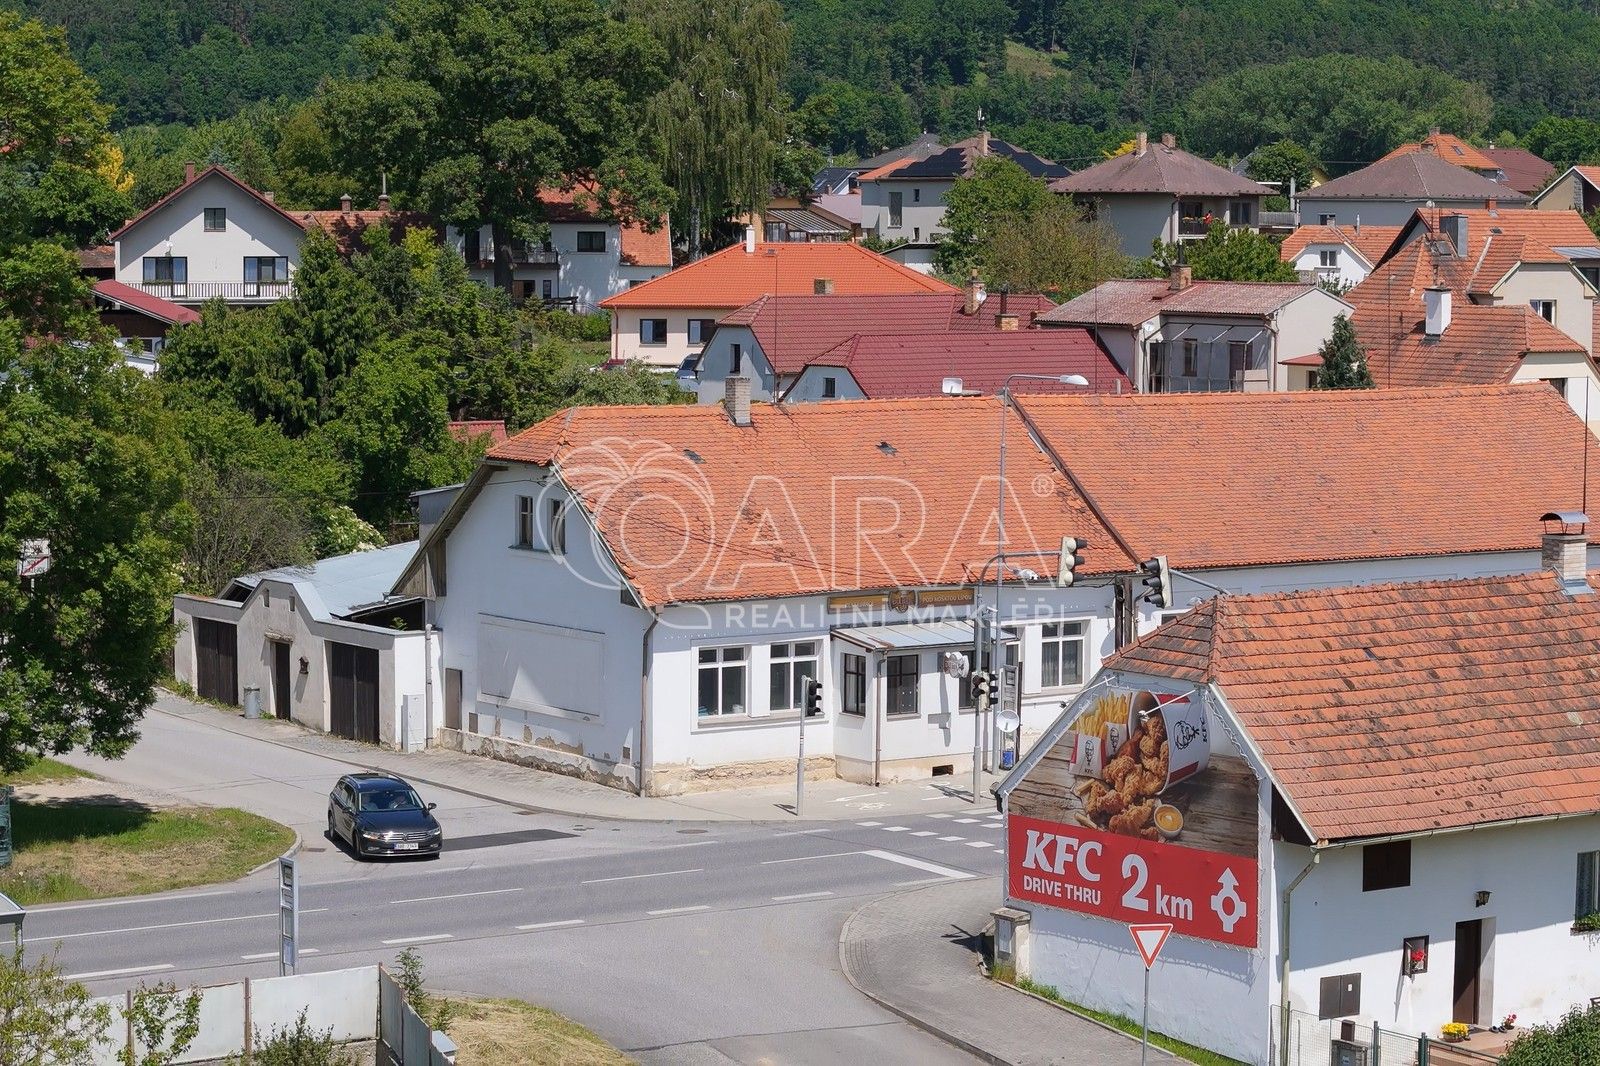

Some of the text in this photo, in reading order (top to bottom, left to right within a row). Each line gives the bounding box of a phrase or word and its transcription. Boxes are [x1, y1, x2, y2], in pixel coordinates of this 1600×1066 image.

[1022, 829, 1103, 882] KFC
[1023, 875, 1101, 906] DRIVE THRU
[1121, 853, 1194, 921] 2 km
